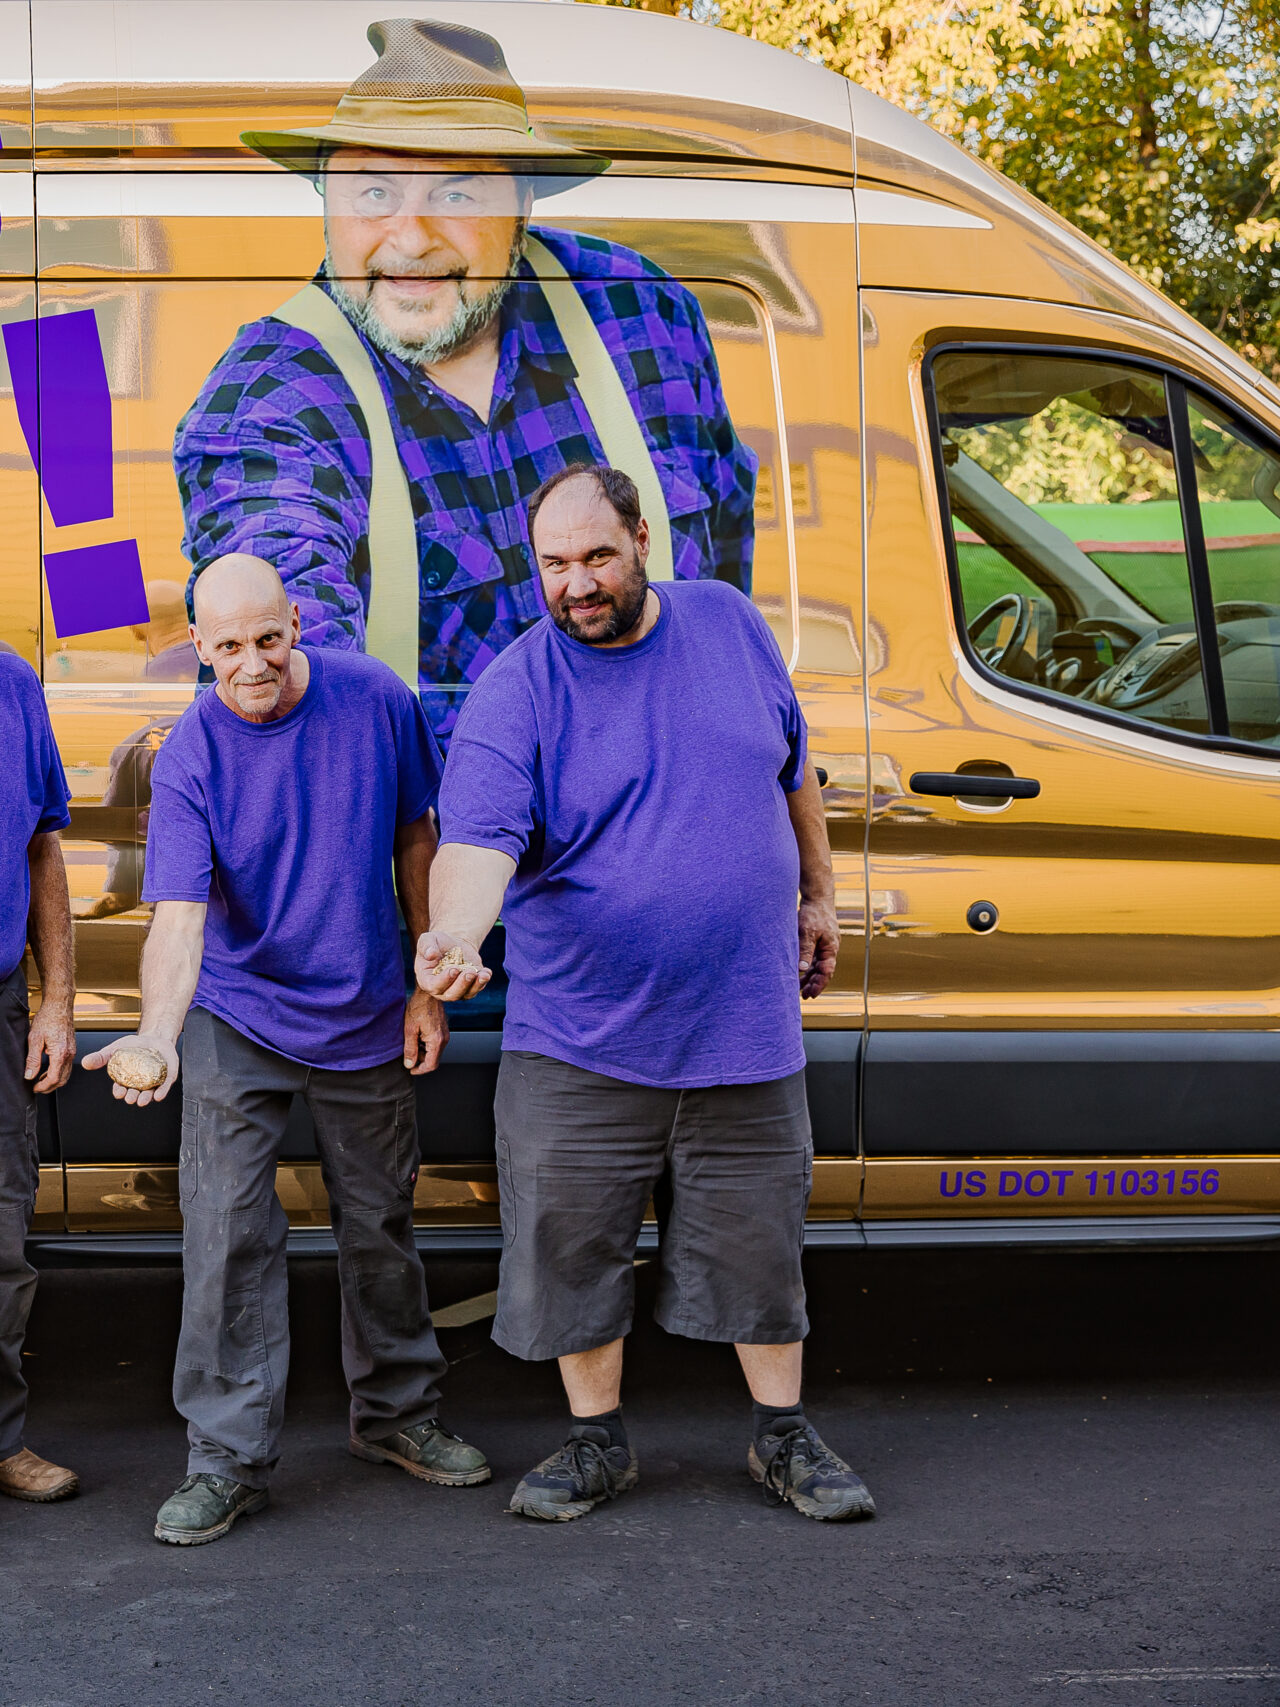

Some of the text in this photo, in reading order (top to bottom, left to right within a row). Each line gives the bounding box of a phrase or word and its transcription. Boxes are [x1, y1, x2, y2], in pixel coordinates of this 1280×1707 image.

[939, 1168, 1219, 1198] US DOT 1103156
